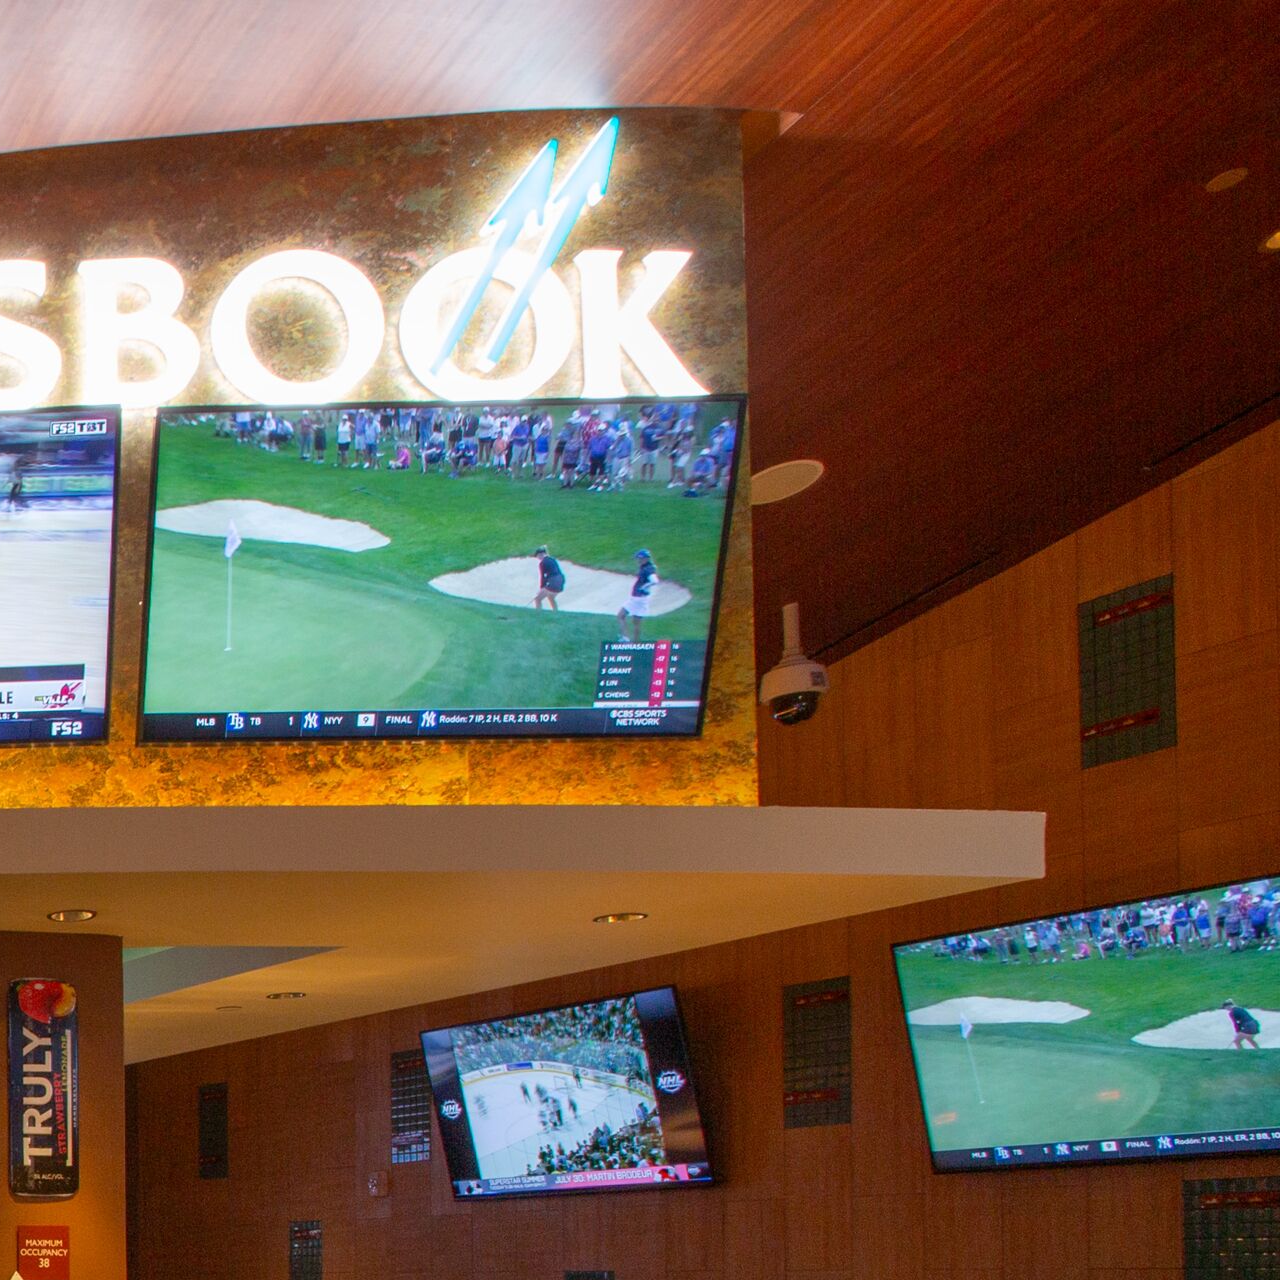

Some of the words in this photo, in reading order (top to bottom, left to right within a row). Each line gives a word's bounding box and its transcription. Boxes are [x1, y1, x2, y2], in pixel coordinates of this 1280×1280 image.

[53, 424, 75, 434] FS2
[12, 712, 18, 720] 4
[439, 713, 467, 724] Rodón:
[469, 714, 474, 723] 7
[475, 714, 485, 724] IP,
[486, 714, 491, 723] 2
[503, 714, 516, 724] ER,
[518, 714, 523, 723] 2
[540, 713, 549, 722] 10
[550, 713, 558, 722] K
[634, 710, 667, 718] SPORTS
[197, 718, 215, 727] MLB
[250, 717, 261, 726] TB
[324, 716, 343, 725] NYY
[385, 715, 413, 725] FINAL
[616, 718, 659, 726] NETWORK
[51, 722, 82, 736] FS2
[658, 1076, 684, 1086] NHL
[22, 1026, 53, 1166] TRULY
[54, 1073, 66, 1154] STRAWBERRY
[443, 1104, 461, 1115] NHL
[555, 1175, 571, 1184] JULY
[587, 1172, 615, 1182] MARTIN
[616, 1169, 653, 1181] BRODEUR
[25, 1239, 63, 1247] MAXIMUM
[20, 1249, 68, 1257] OCCUPANCY
[38, 1258, 50, 1268] 38
